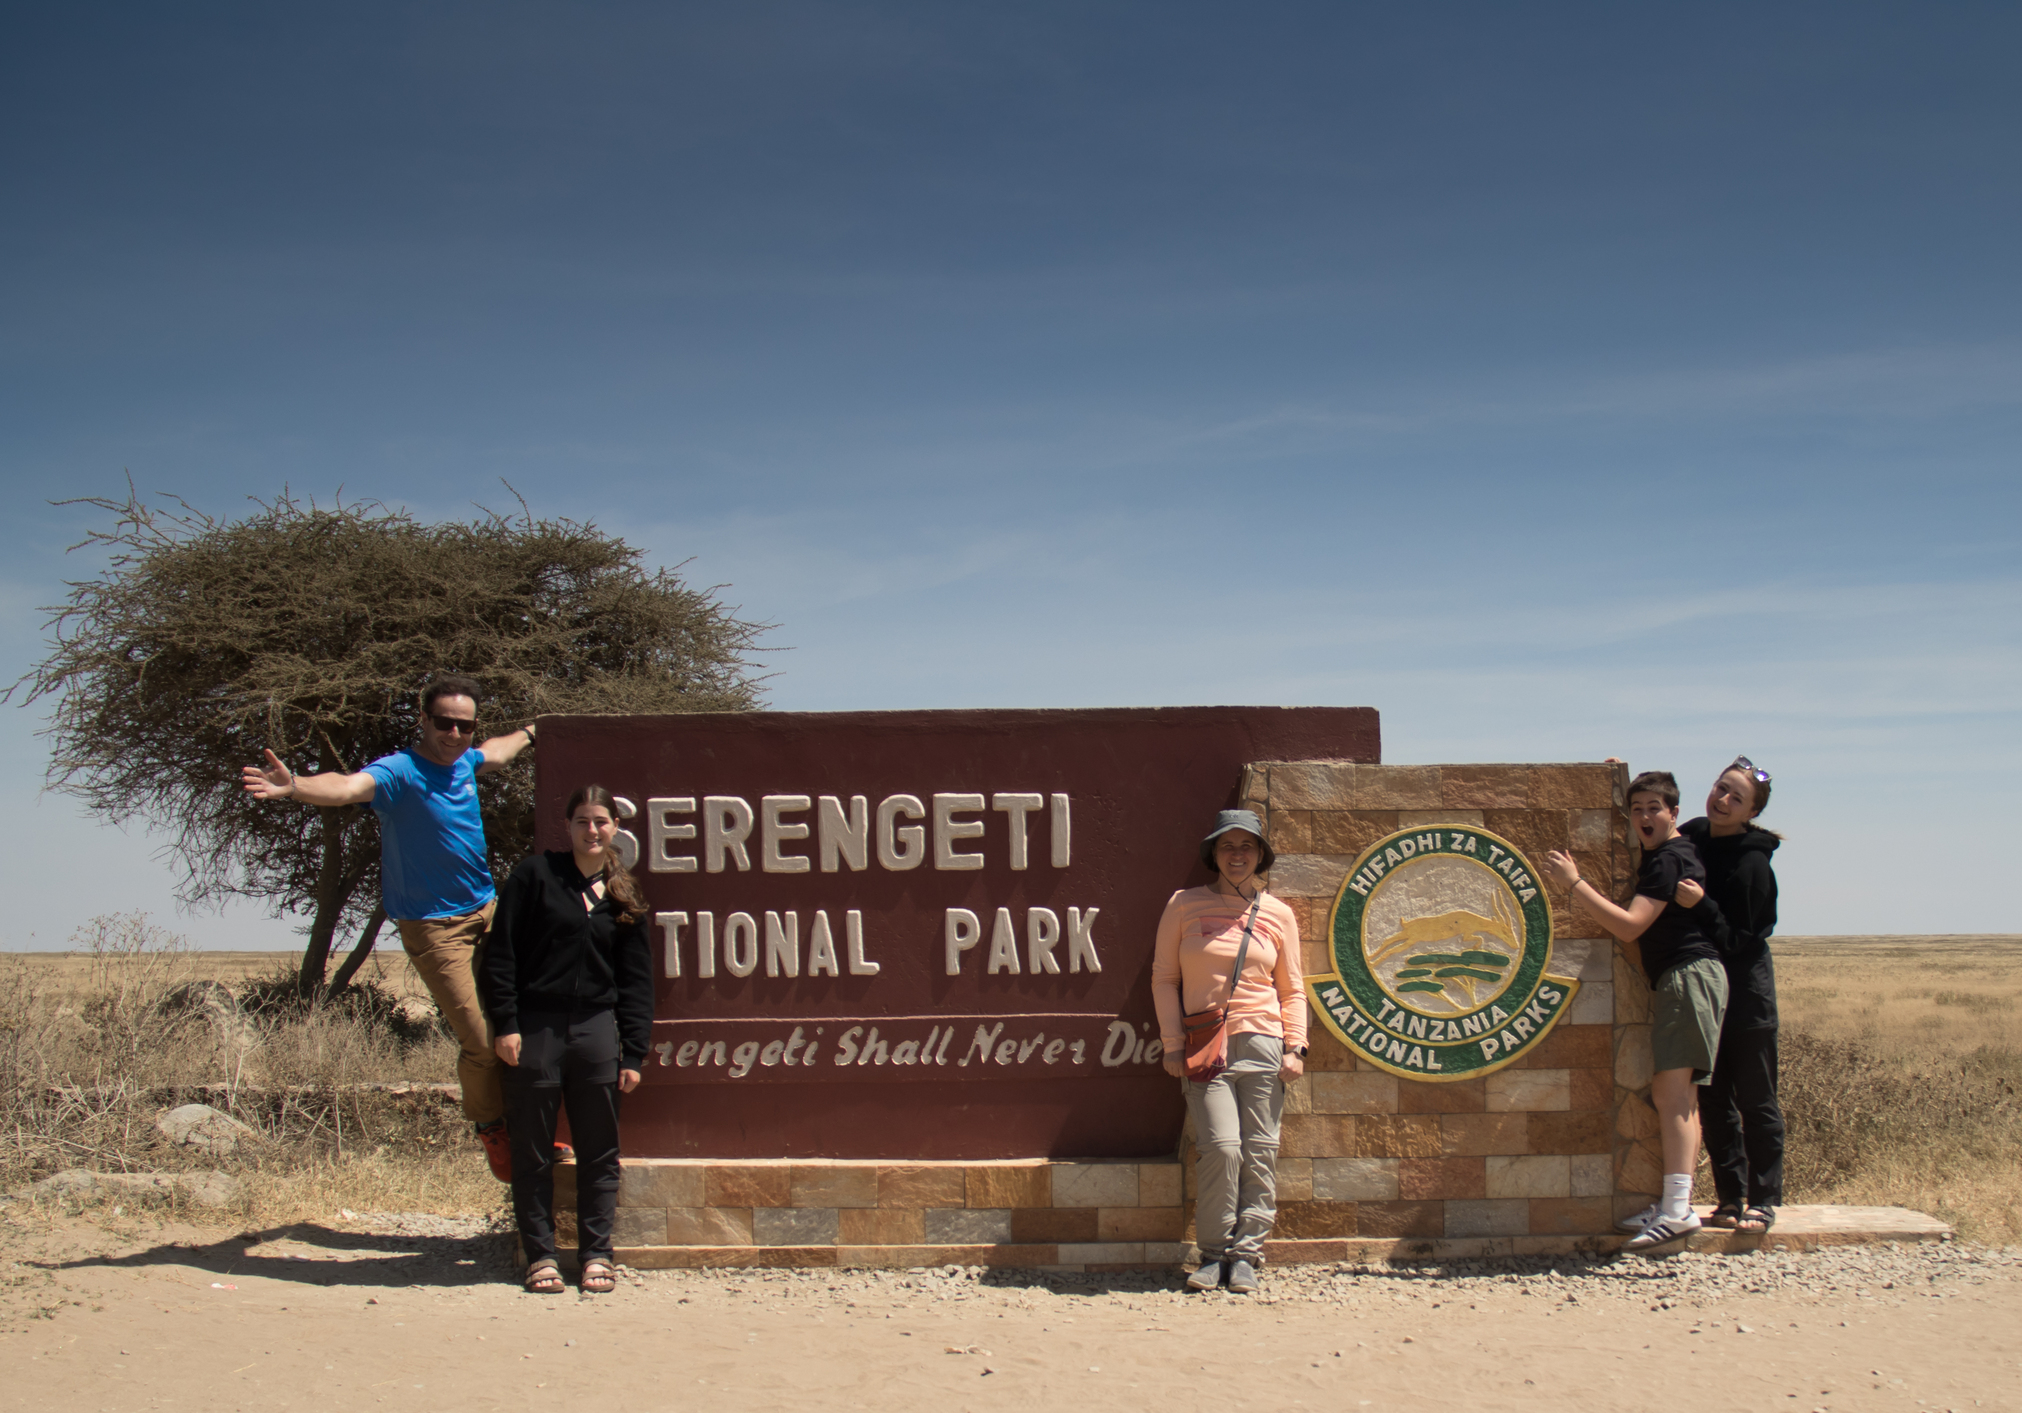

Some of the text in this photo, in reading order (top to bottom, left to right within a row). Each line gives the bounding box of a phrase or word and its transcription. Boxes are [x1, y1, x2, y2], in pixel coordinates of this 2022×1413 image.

[1349, 833, 1538, 904] HIFADHI ZA TAIFA
[656, 906, 1103, 979] TIONAL PARK
[641, 1020, 1163, 1079] rengeti Shall Never Die
[1321, 985, 1562, 1071] NATIONAL PARKS
[1374, 998, 1509, 1042] TANZANIA
